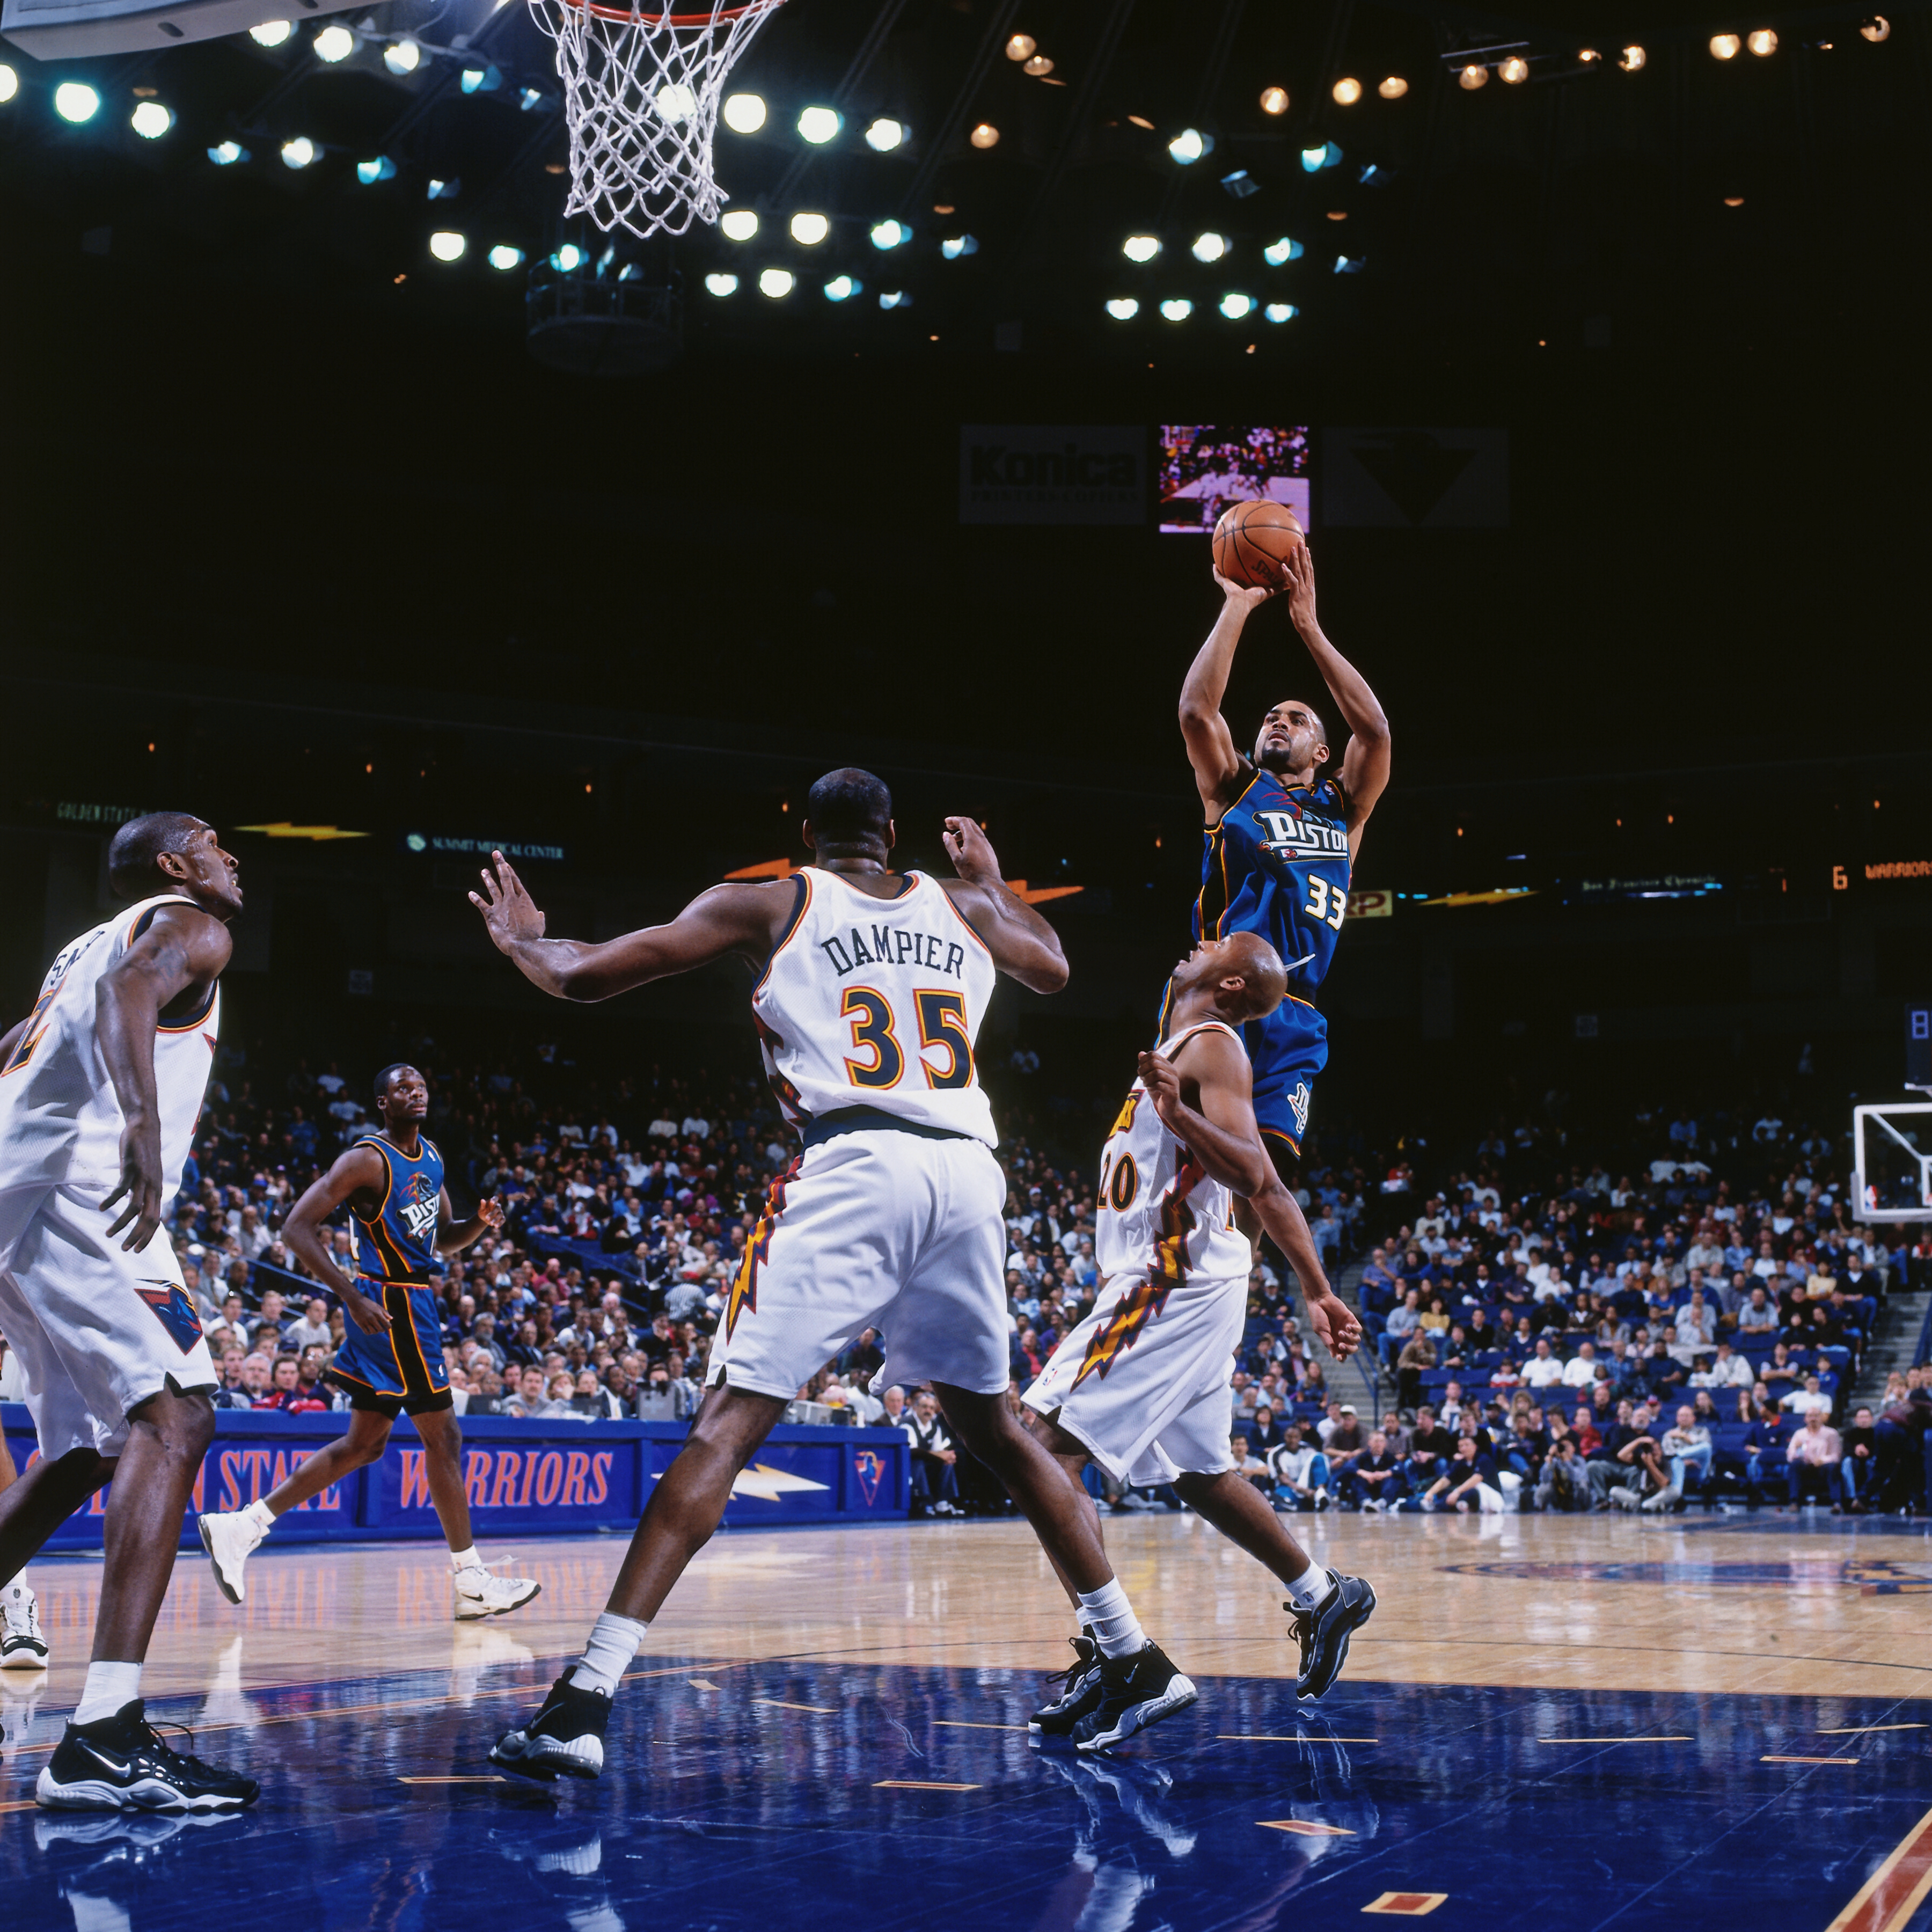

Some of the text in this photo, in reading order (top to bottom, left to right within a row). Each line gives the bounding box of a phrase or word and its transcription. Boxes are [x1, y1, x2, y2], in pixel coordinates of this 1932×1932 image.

[970, 442, 1137, 486] Konica
[1832, 865, 1848, 890] 6
[1865, 860, 1932, 879] WARRIOR
[1305, 874, 1346, 930] 33
[821, 924, 964, 979] DAMPIER
[840, 985, 974, 1091] 35
[399, 1450, 613, 1507] WRRIORS
